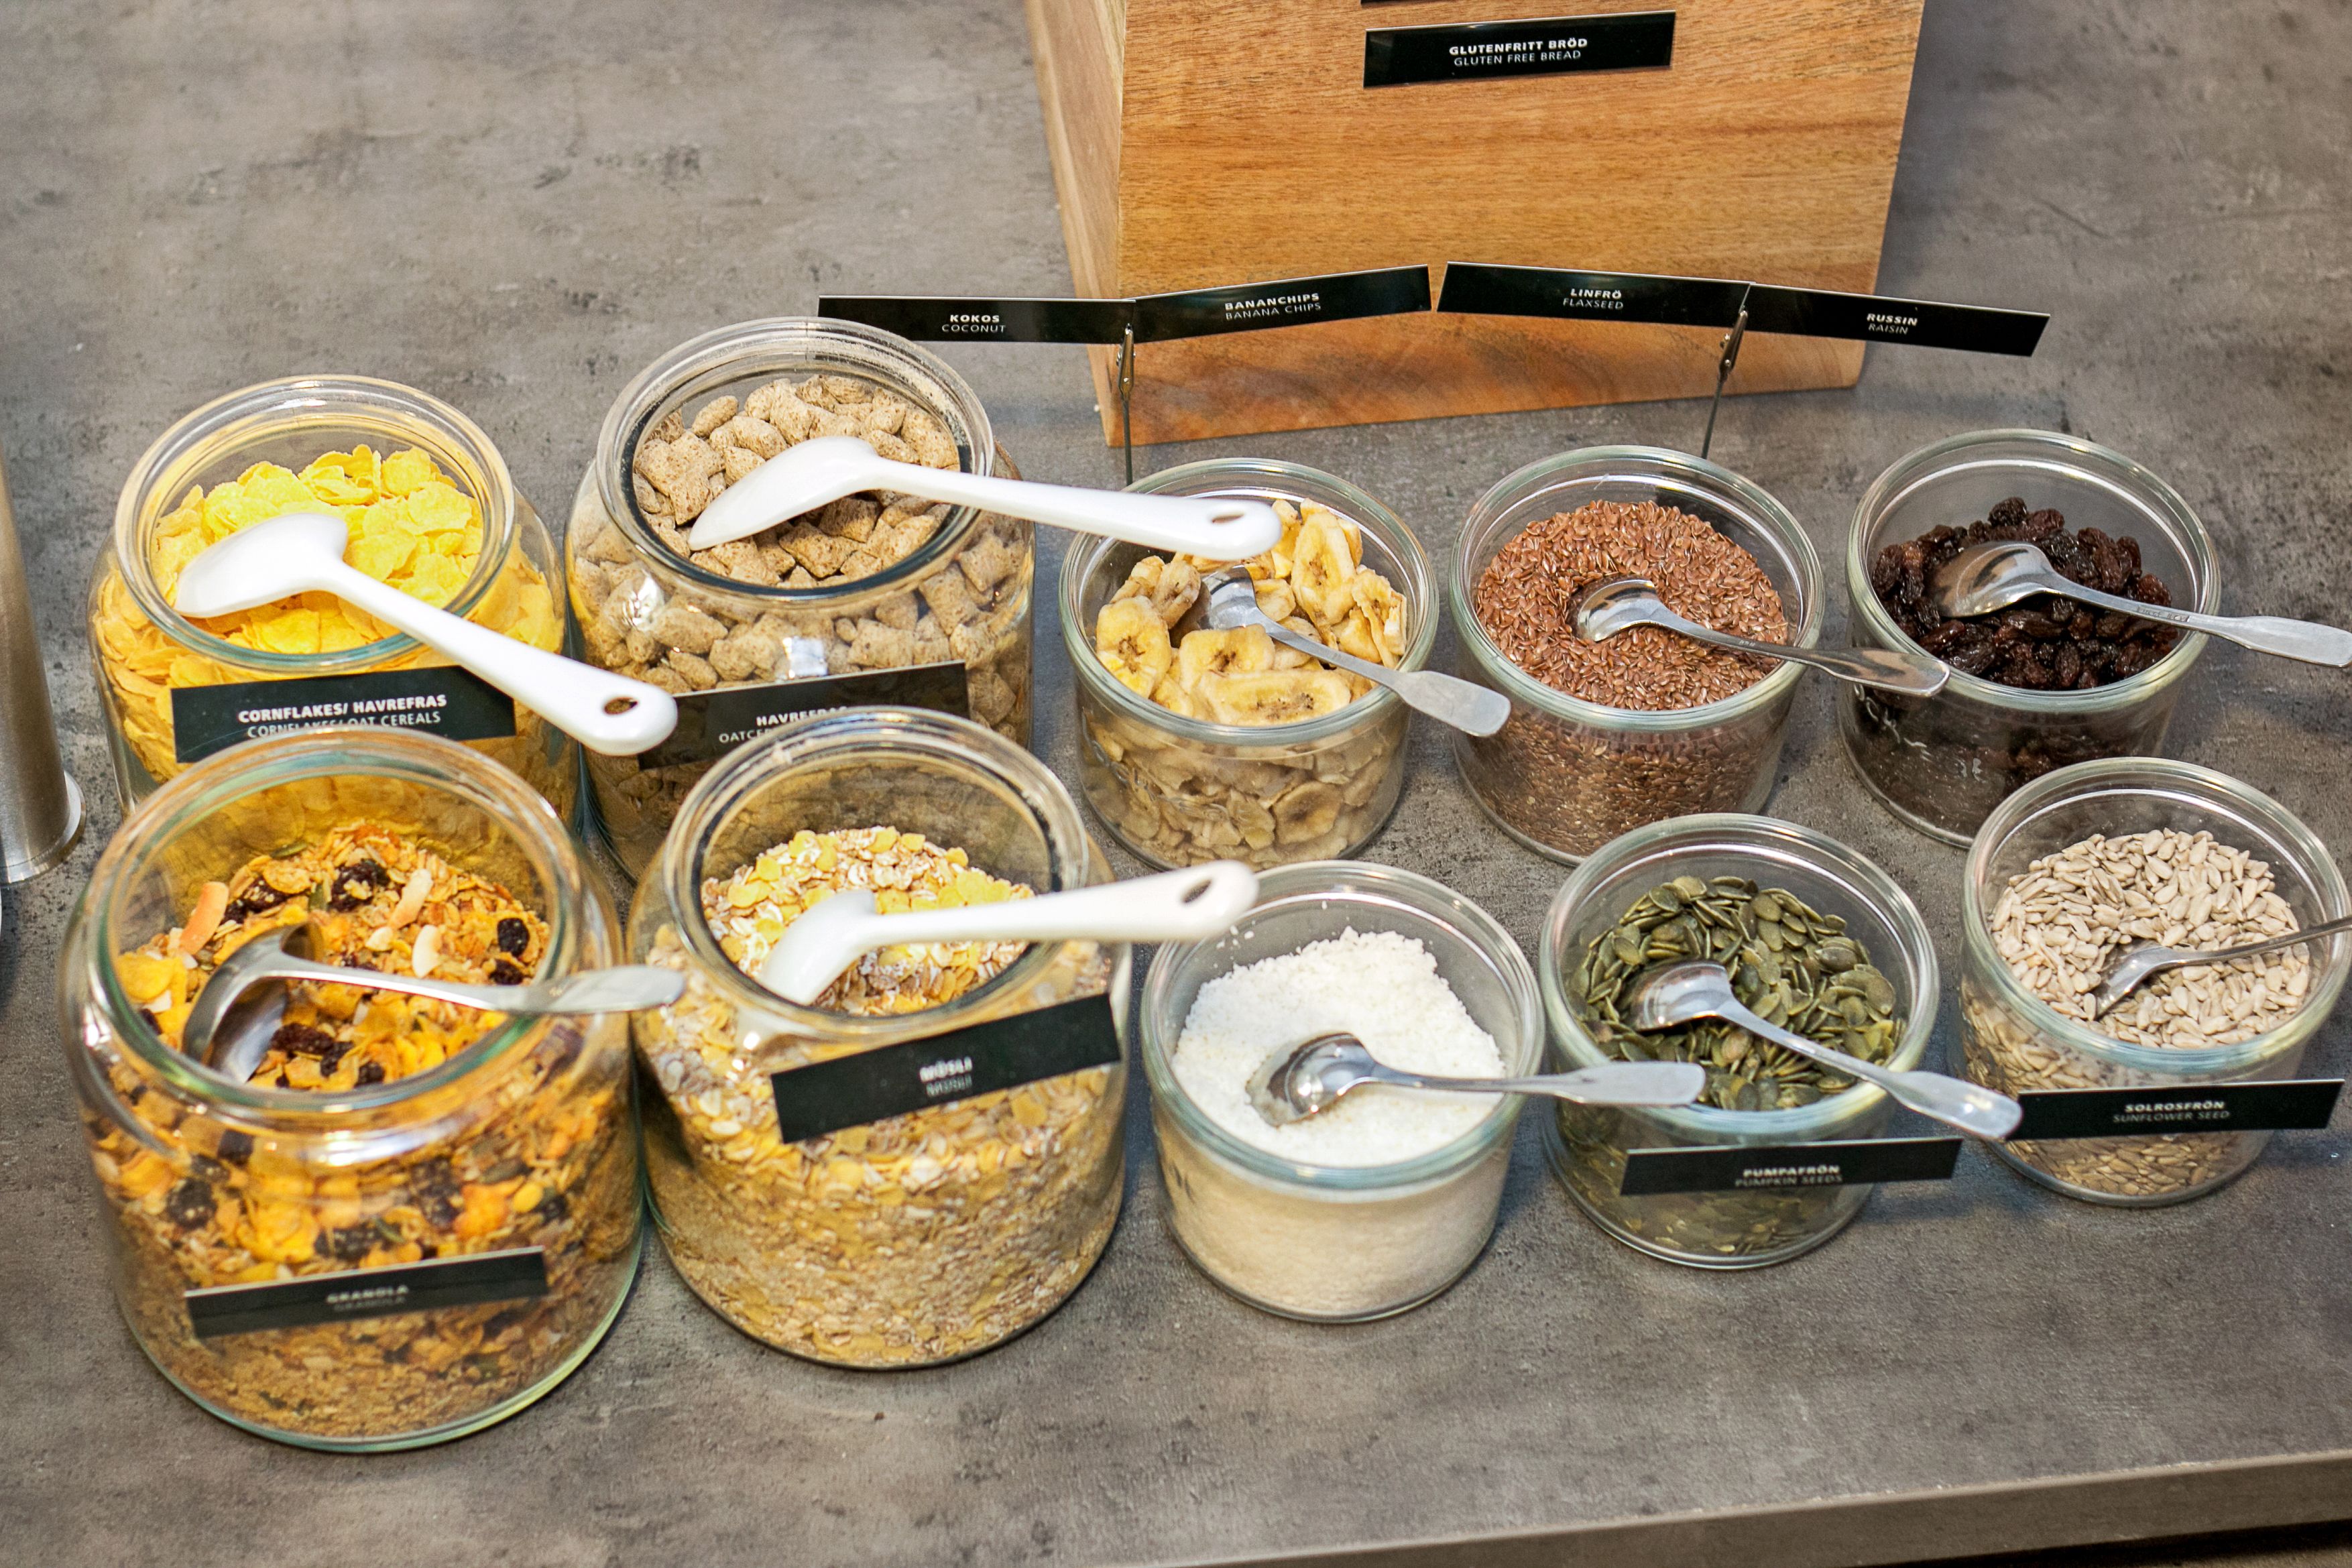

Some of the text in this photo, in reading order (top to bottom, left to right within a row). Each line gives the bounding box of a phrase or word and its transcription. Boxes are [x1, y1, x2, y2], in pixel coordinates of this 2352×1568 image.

[1450, 38, 1588, 55] GLUTENFRITT BRÖD
[1454, 50, 1581, 66] GLUTEN FREE BREAD
[1570, 288, 1622, 300] LINFRÖ
[1224, 293, 1319, 311] BANANCHIPS
[1563, 298, 1624, 310] FLAXSEED
[1226, 302, 1321, 320] BANANA CHIPS
[950, 314, 1000, 323] KOKOS
[1867, 313, 1918, 326] RUSSIN
[942, 324, 1006, 333] COCONUT
[1868, 322, 1909, 335] RAISIN
[239, 695, 447, 723] CORNFLAKES/ HAVREFRAS
[380, 711, 440, 727] CEREALS
[2125, 1100, 2225, 1113] SOLROSFRÖN
[2113, 1110, 2230, 1123] SUNFLOWER SEED
[1743, 1164, 1840, 1177] PUMPAFRÖN
[1735, 1174, 1842, 1187] PUMPKIN SEEDS
